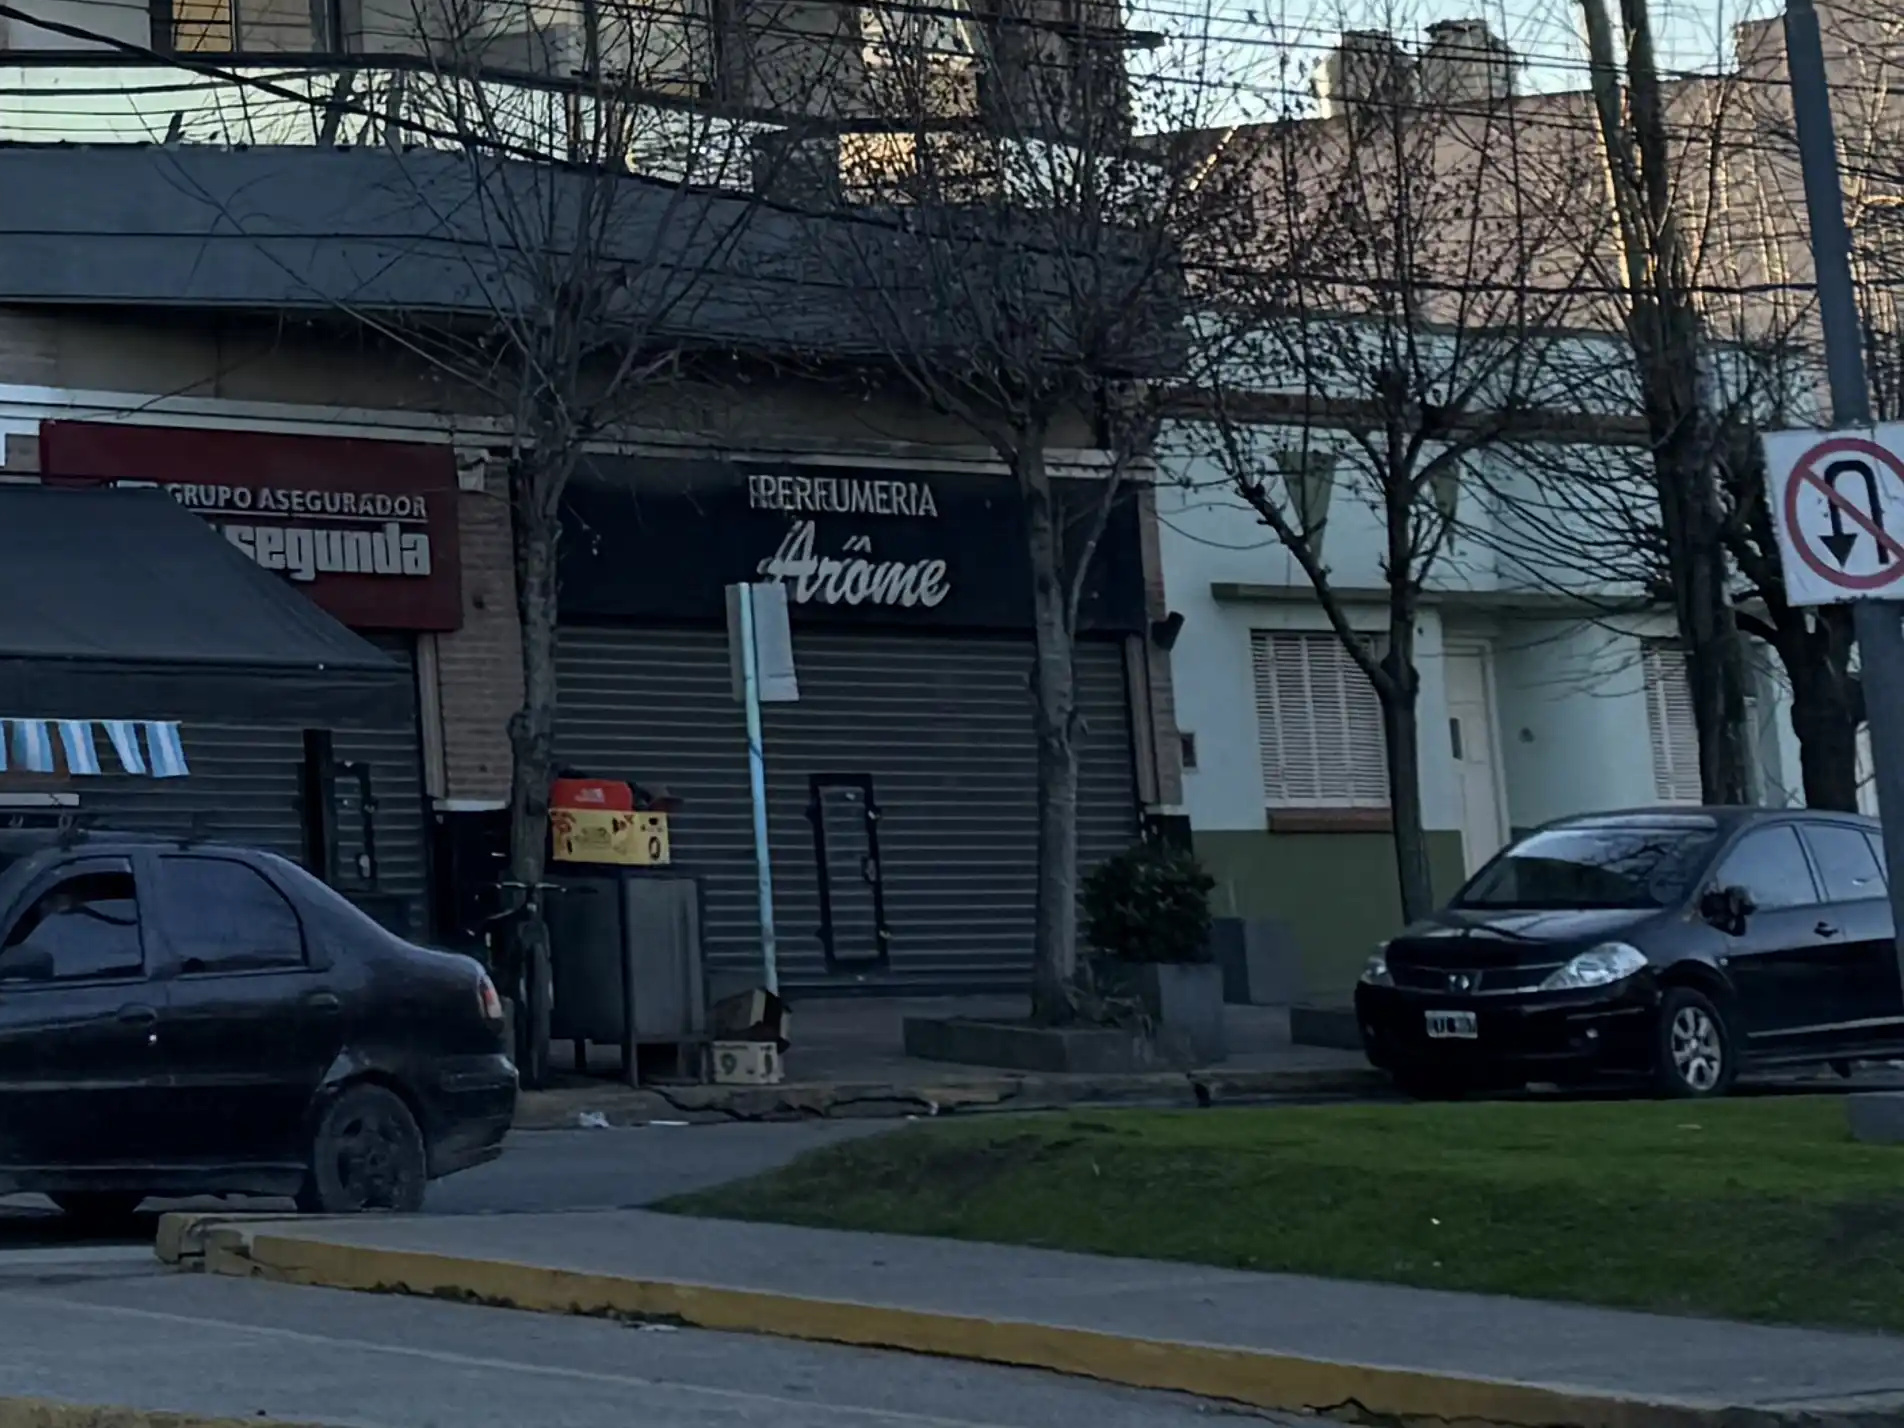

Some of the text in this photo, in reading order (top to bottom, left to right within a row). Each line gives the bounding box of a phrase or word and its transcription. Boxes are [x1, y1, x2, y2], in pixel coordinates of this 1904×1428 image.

[169, 483, 429, 518] GRUPO ASEGURADOR
[748, 475, 940, 518] PERFUMERIA
